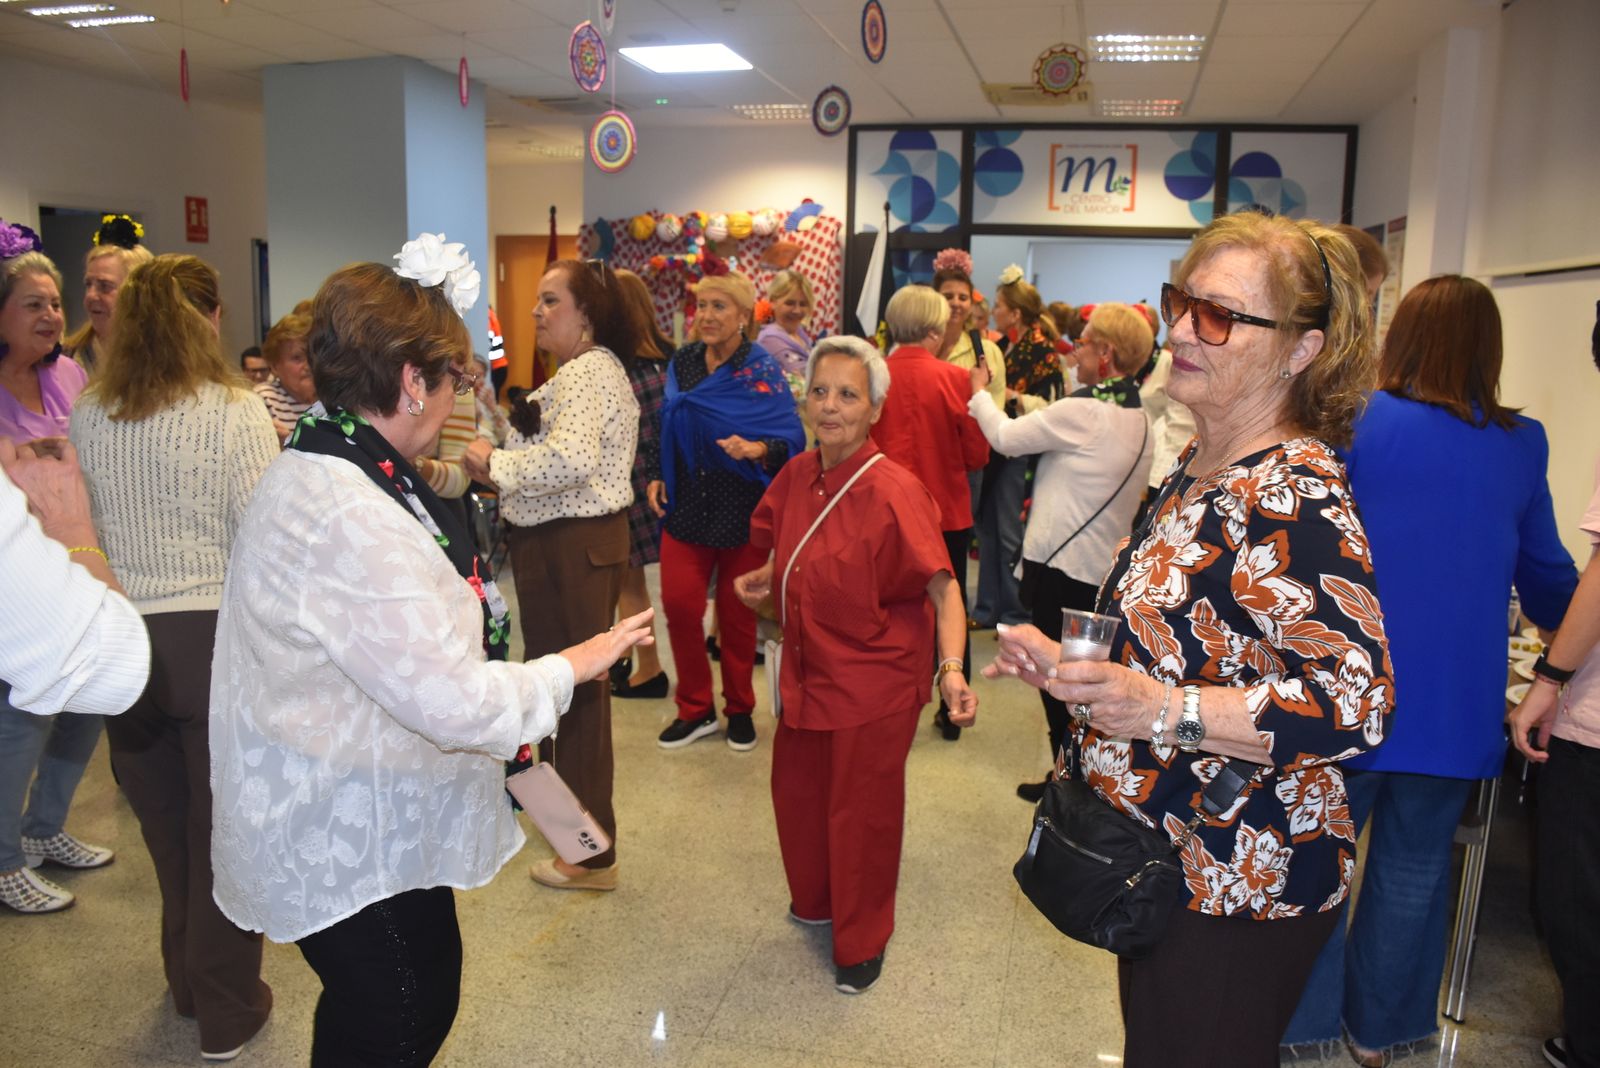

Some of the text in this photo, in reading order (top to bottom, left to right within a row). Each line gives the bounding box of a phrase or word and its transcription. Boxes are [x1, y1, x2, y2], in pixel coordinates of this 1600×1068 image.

[1070, 194, 1112, 203] CENTRO
[1063, 204, 1120, 214] DEL MAYOR
